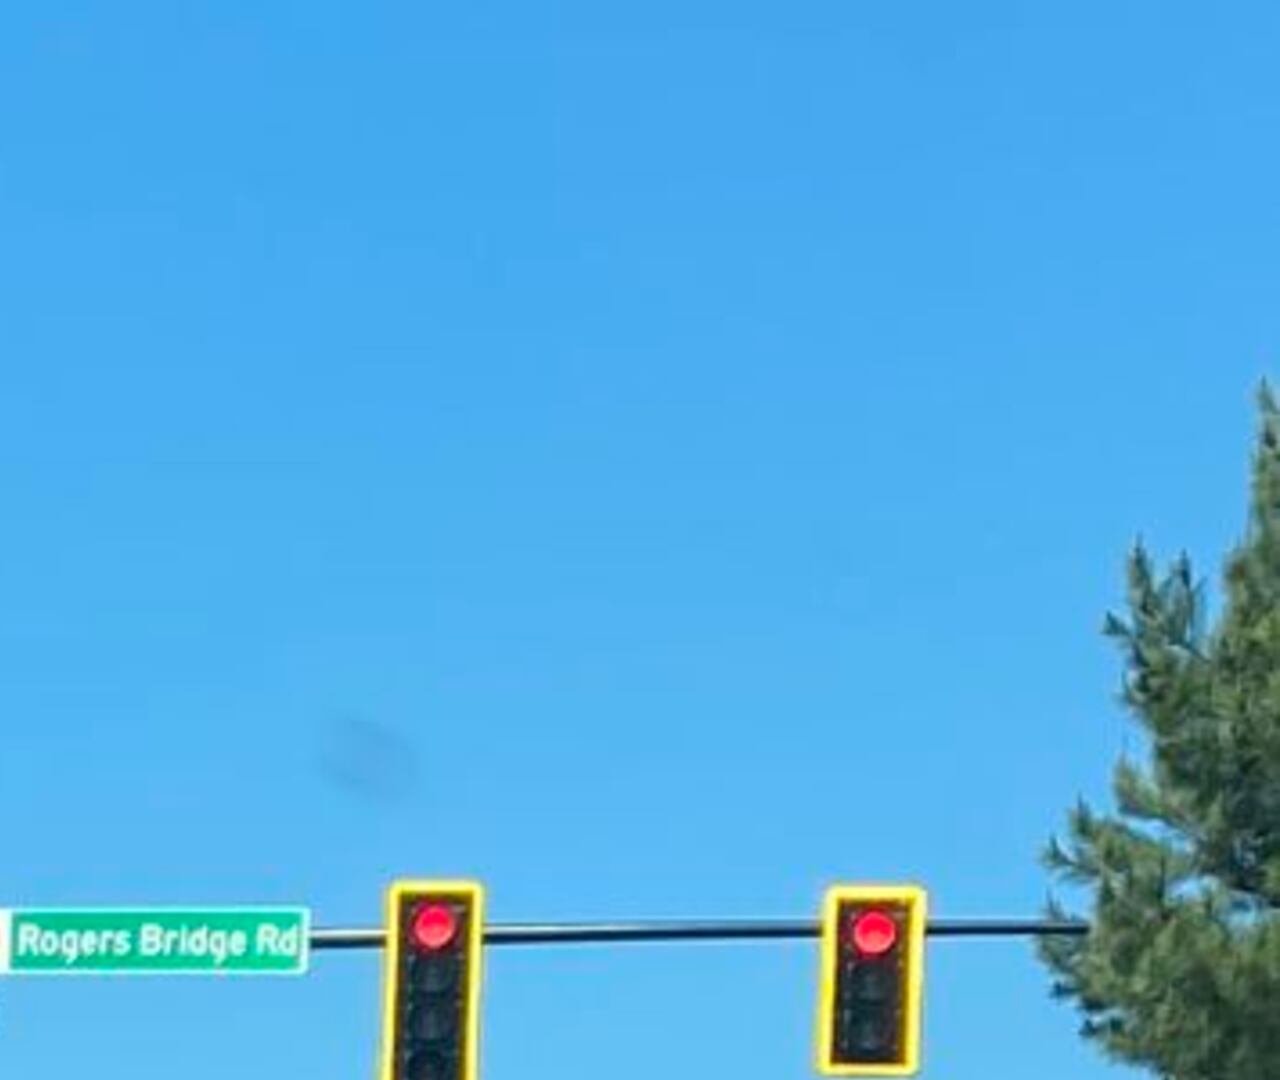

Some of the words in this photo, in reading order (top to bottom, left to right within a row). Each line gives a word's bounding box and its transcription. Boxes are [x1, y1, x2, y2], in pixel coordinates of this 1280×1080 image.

[18, 922, 132, 965] Rogers
[140, 922, 247, 966] Bridge
[256, 922, 298, 957] Rd
